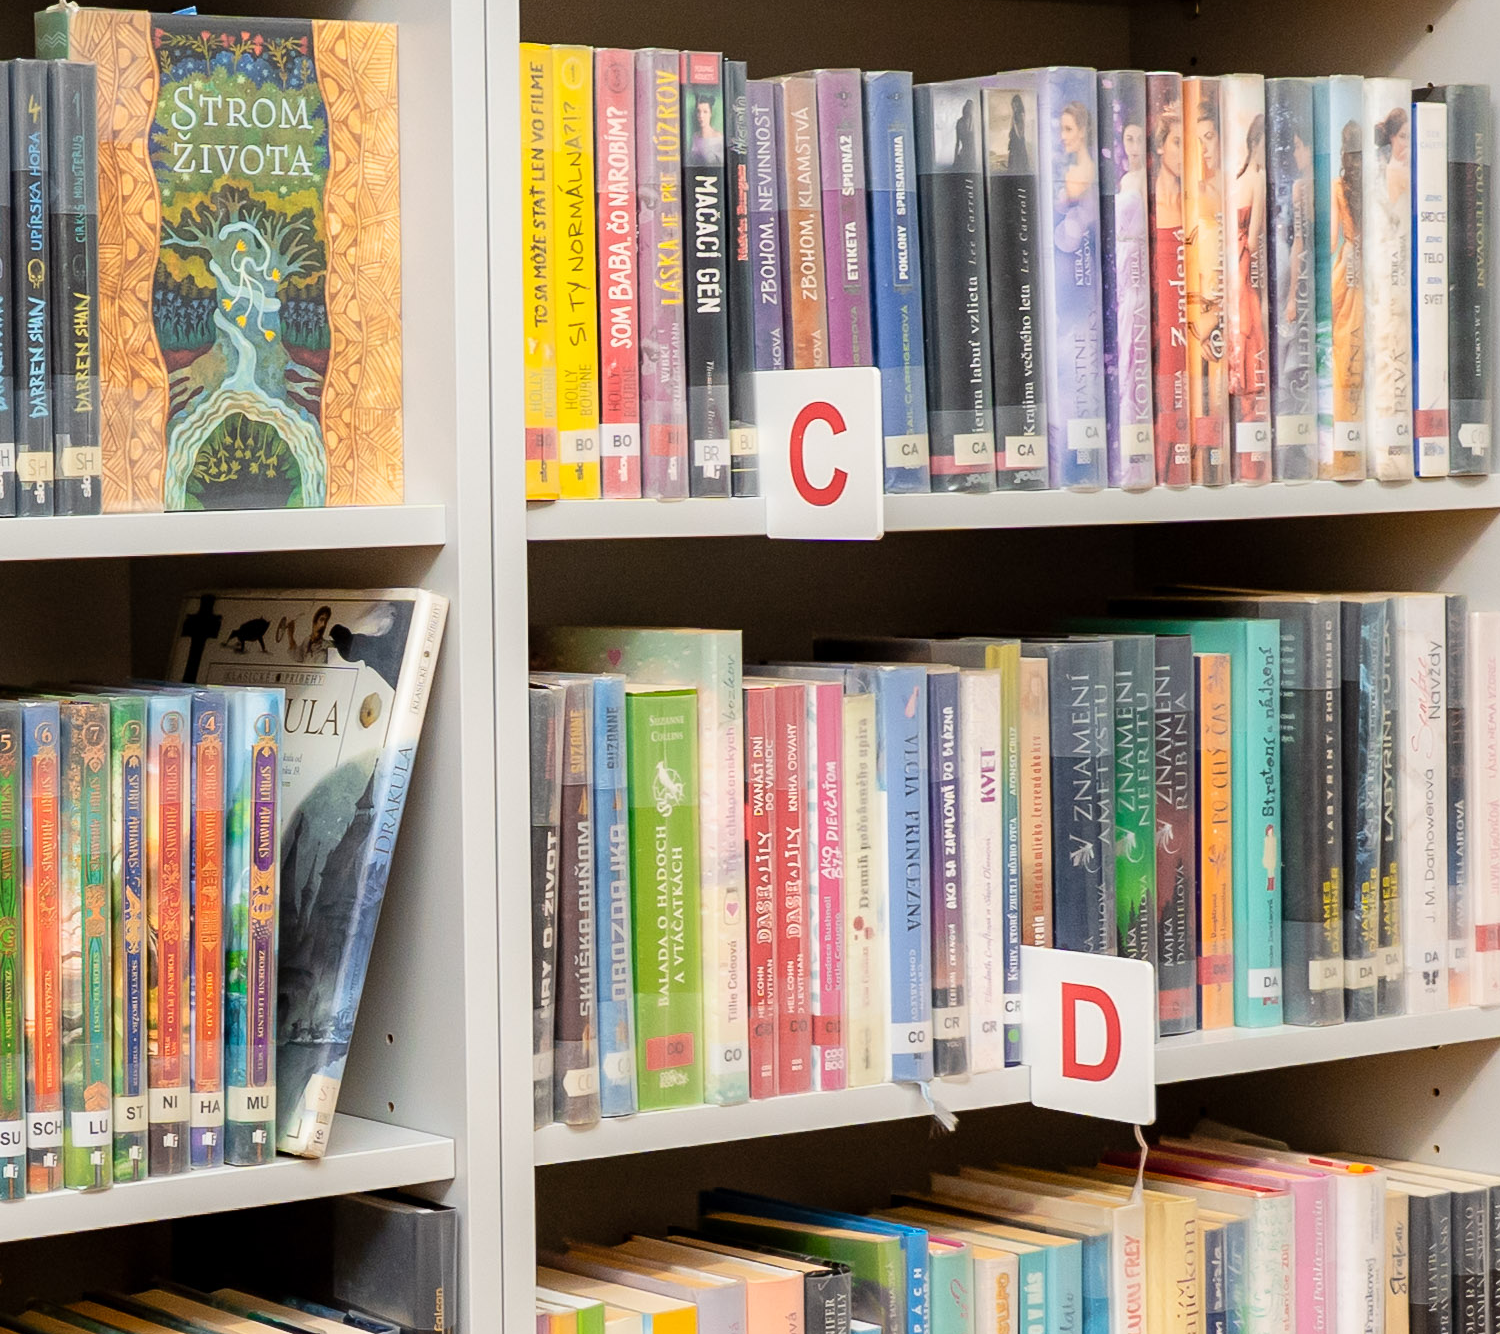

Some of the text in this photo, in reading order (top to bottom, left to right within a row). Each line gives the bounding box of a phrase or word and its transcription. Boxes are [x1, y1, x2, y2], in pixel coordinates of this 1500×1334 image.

[171, 83, 312, 133] STROM
[172, 141, 314, 176] ŽIVOTA
[695, 175, 720, 314] MAČACÍ GÉN
[788, 399, 848, 506] C
[980, 747, 996, 803] KVET
[1062, 983, 1121, 1082] D
[0, 1128, 21, 1145] SU
